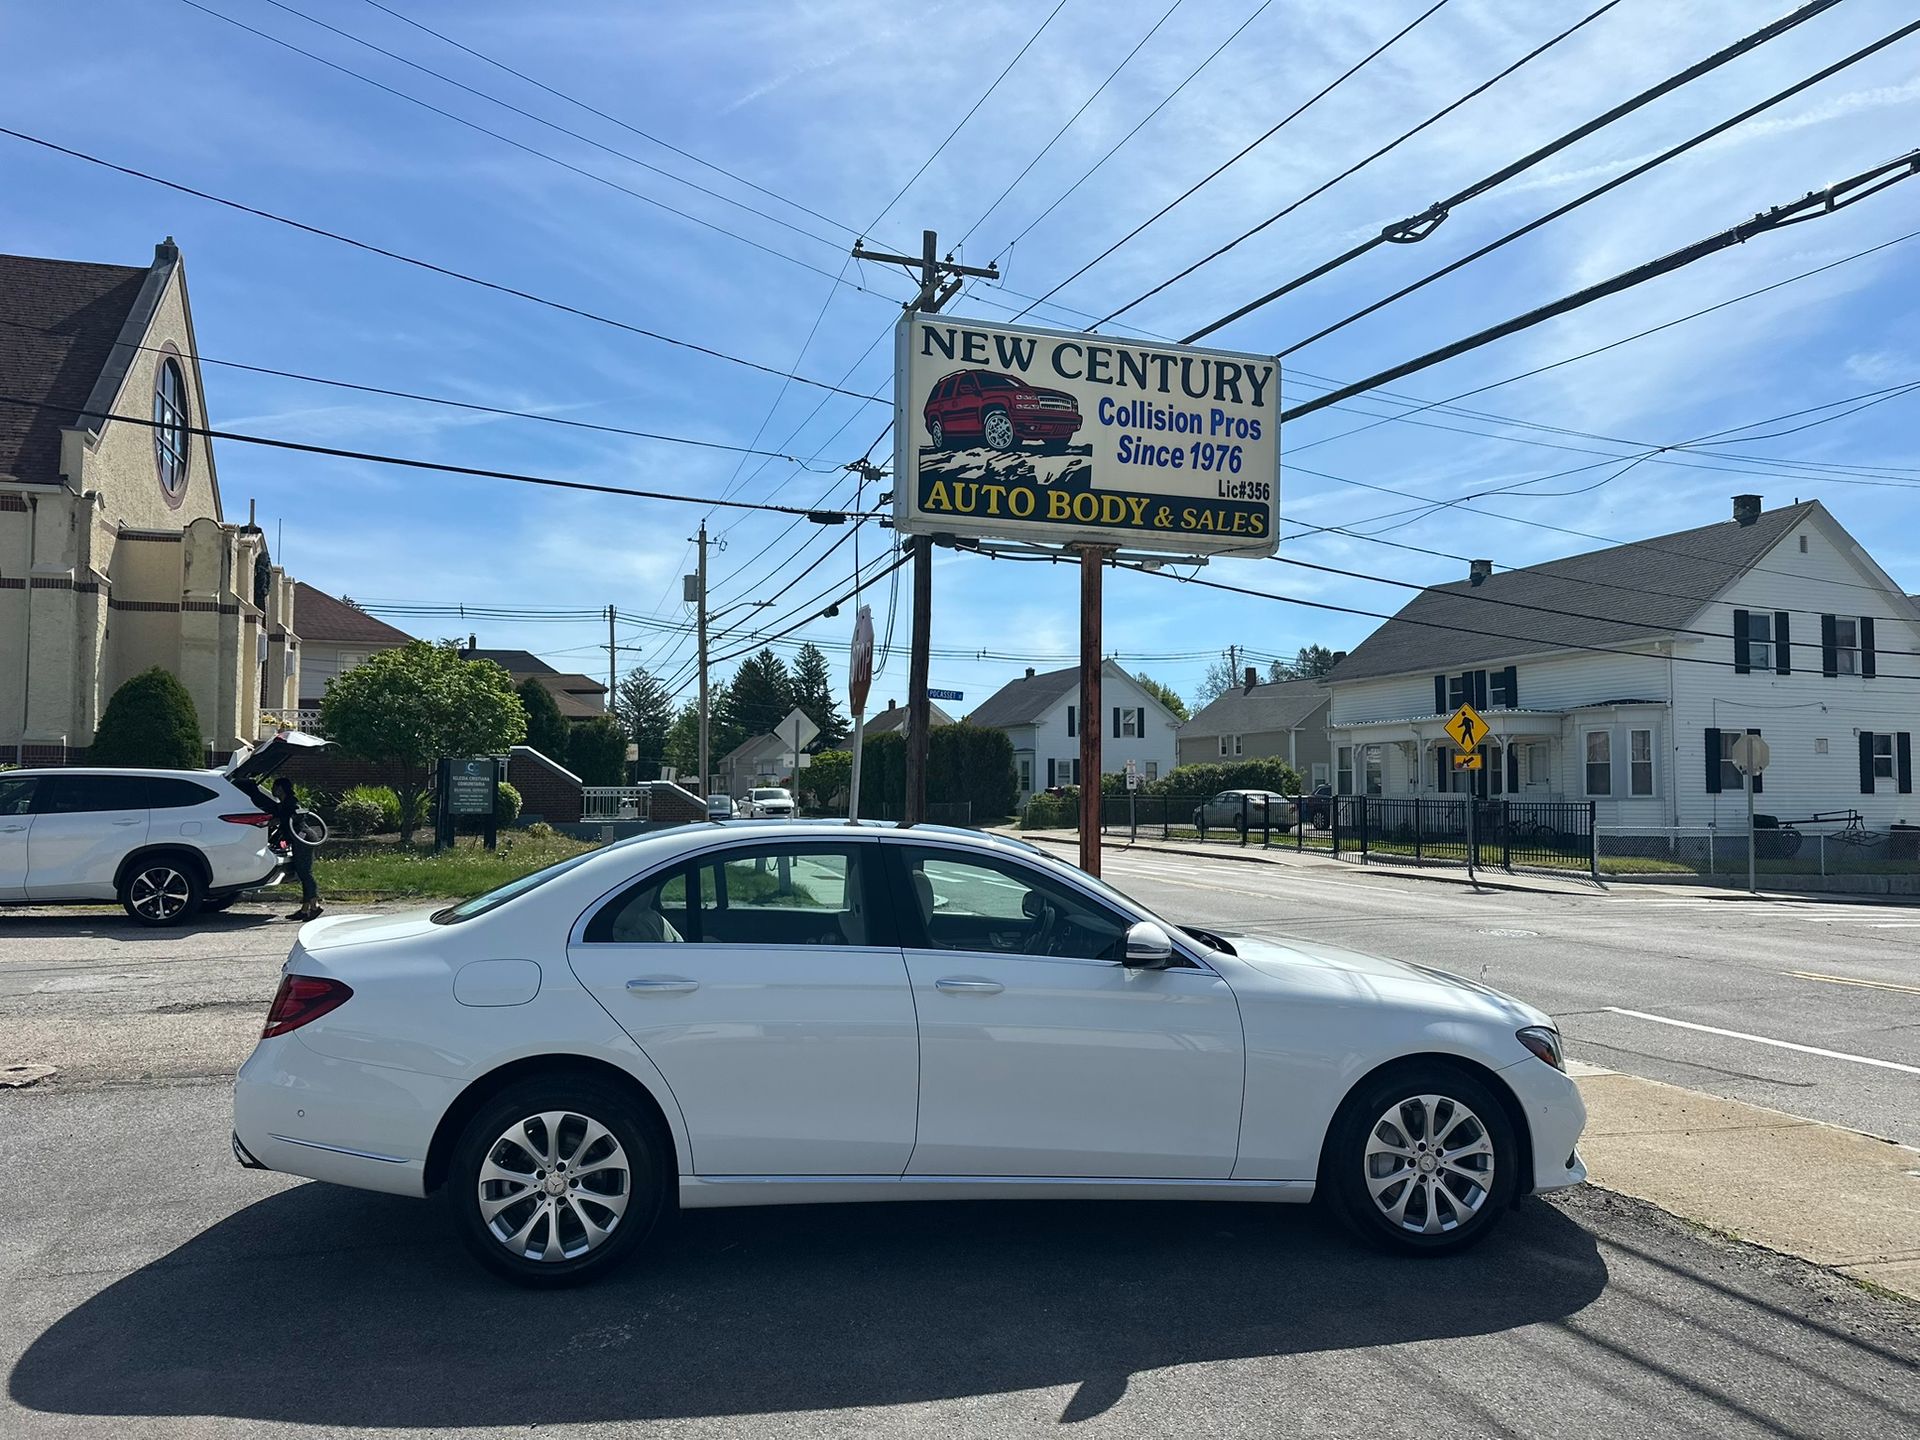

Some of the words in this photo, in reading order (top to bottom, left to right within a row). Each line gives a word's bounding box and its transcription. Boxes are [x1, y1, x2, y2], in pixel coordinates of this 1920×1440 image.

[921, 325, 1037, 372] NEW
[1051, 342, 1273, 407] CENTURY
[1099, 396, 1202, 435] Collision
[1210, 408, 1262, 441] Pros
[1117, 434, 1184, 468] Since
[1190, 441, 1242, 474] 1976
[924, 480, 1036, 517] AUTO
[1046, 490, 1150, 530] BODY
[1153, 506, 1174, 528] &
[1180, 508, 1264, 534] SALES
[1217, 479, 1270, 501] Lic#356
[851, 641, 871, 682] STOP
[930, 690, 956, 699] POCASSET
